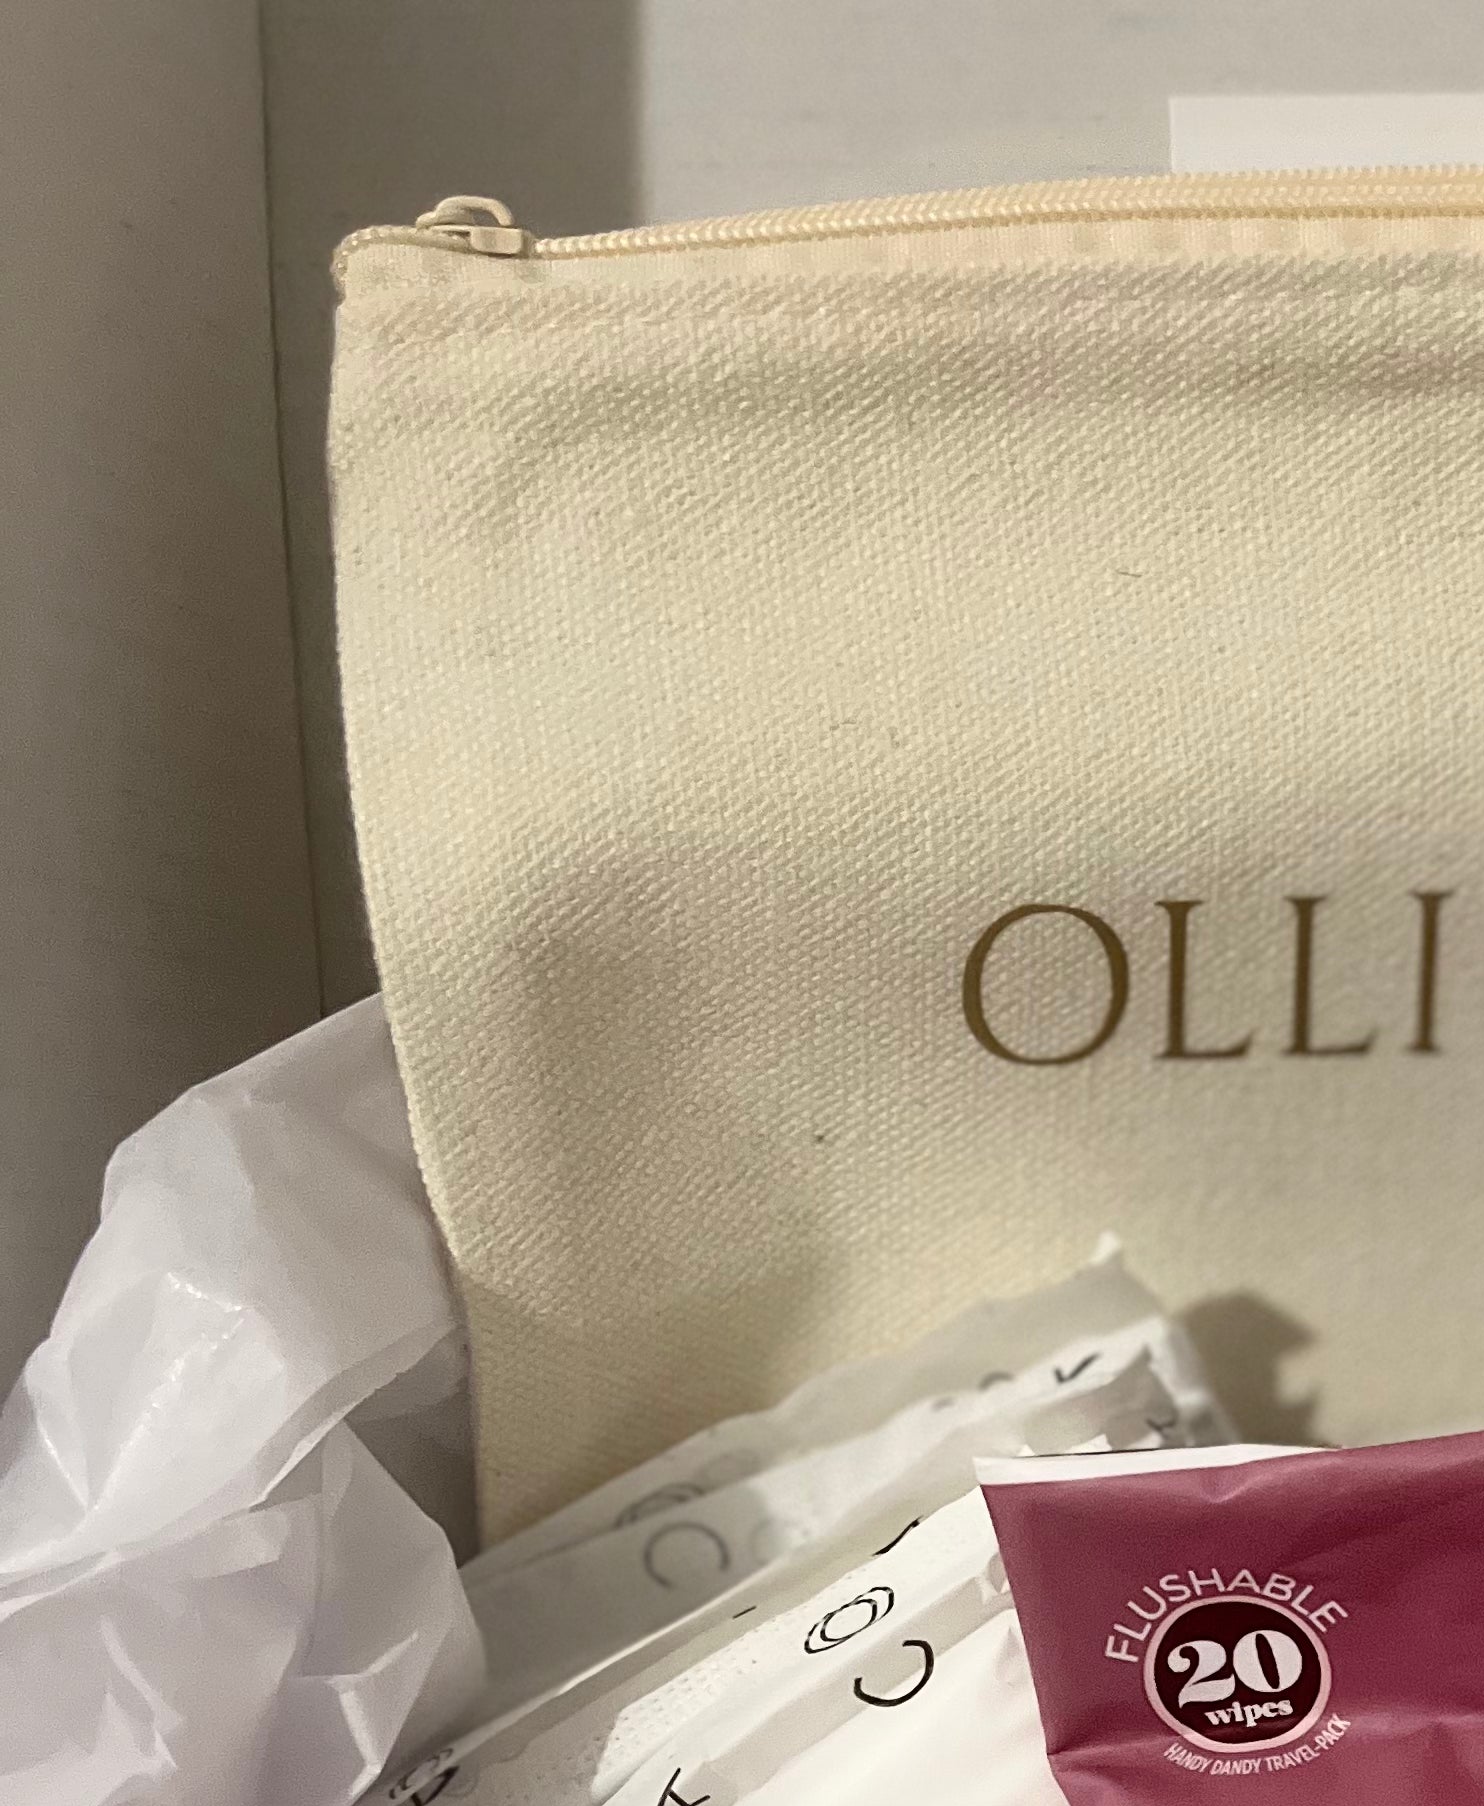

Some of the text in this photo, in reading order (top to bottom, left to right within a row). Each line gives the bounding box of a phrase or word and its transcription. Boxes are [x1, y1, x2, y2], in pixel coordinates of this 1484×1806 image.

[961, 888, 1456, 1067] OLLI
[1104, 1567, 1349, 1664] FLUSHABLE
[1167, 1628, 1303, 1709] 20
[1163, 1712, 1352, 1776] HANDY DANDY TRAVEL-PACK
[1204, 1698, 1294, 1728] wipes
